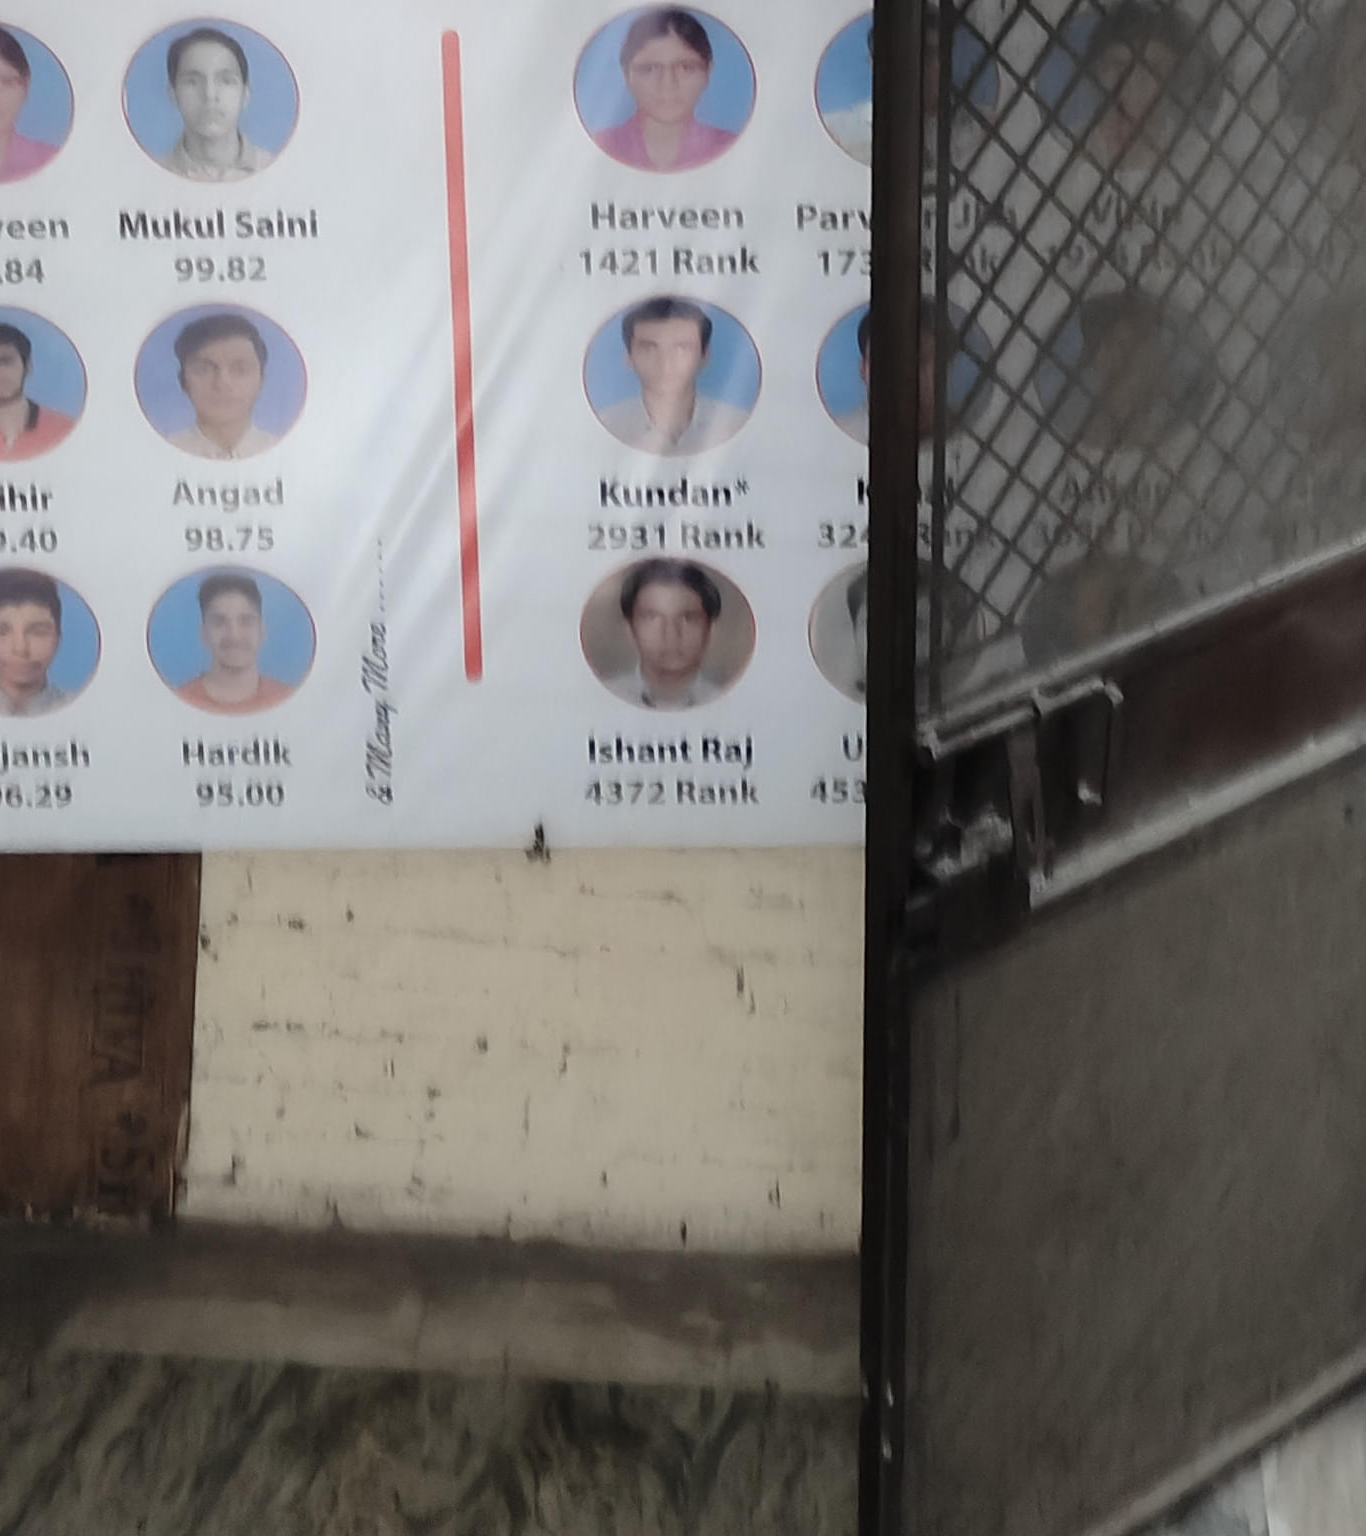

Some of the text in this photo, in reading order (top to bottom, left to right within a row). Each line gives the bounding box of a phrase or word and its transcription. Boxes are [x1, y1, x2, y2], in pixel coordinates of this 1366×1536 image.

[120, 210, 317, 238] Mukul Saini
[592, 203, 743, 229] Harveen
[175, 257, 265, 281] 99.82
[580, 247, 758, 274] 1421 Rank
[173, 480, 283, 511] Angad
[185, 528, 273, 551] 98.75
[589, 522, 764, 549] 2931 Rank
[183, 739, 289, 764] Hardik
[366, 701, 396, 779] Many
[589, 738, 752, 765] Ishant Raj
[197, 784, 283, 804] 95.00
[585, 778, 757, 804] 4372 Rank
